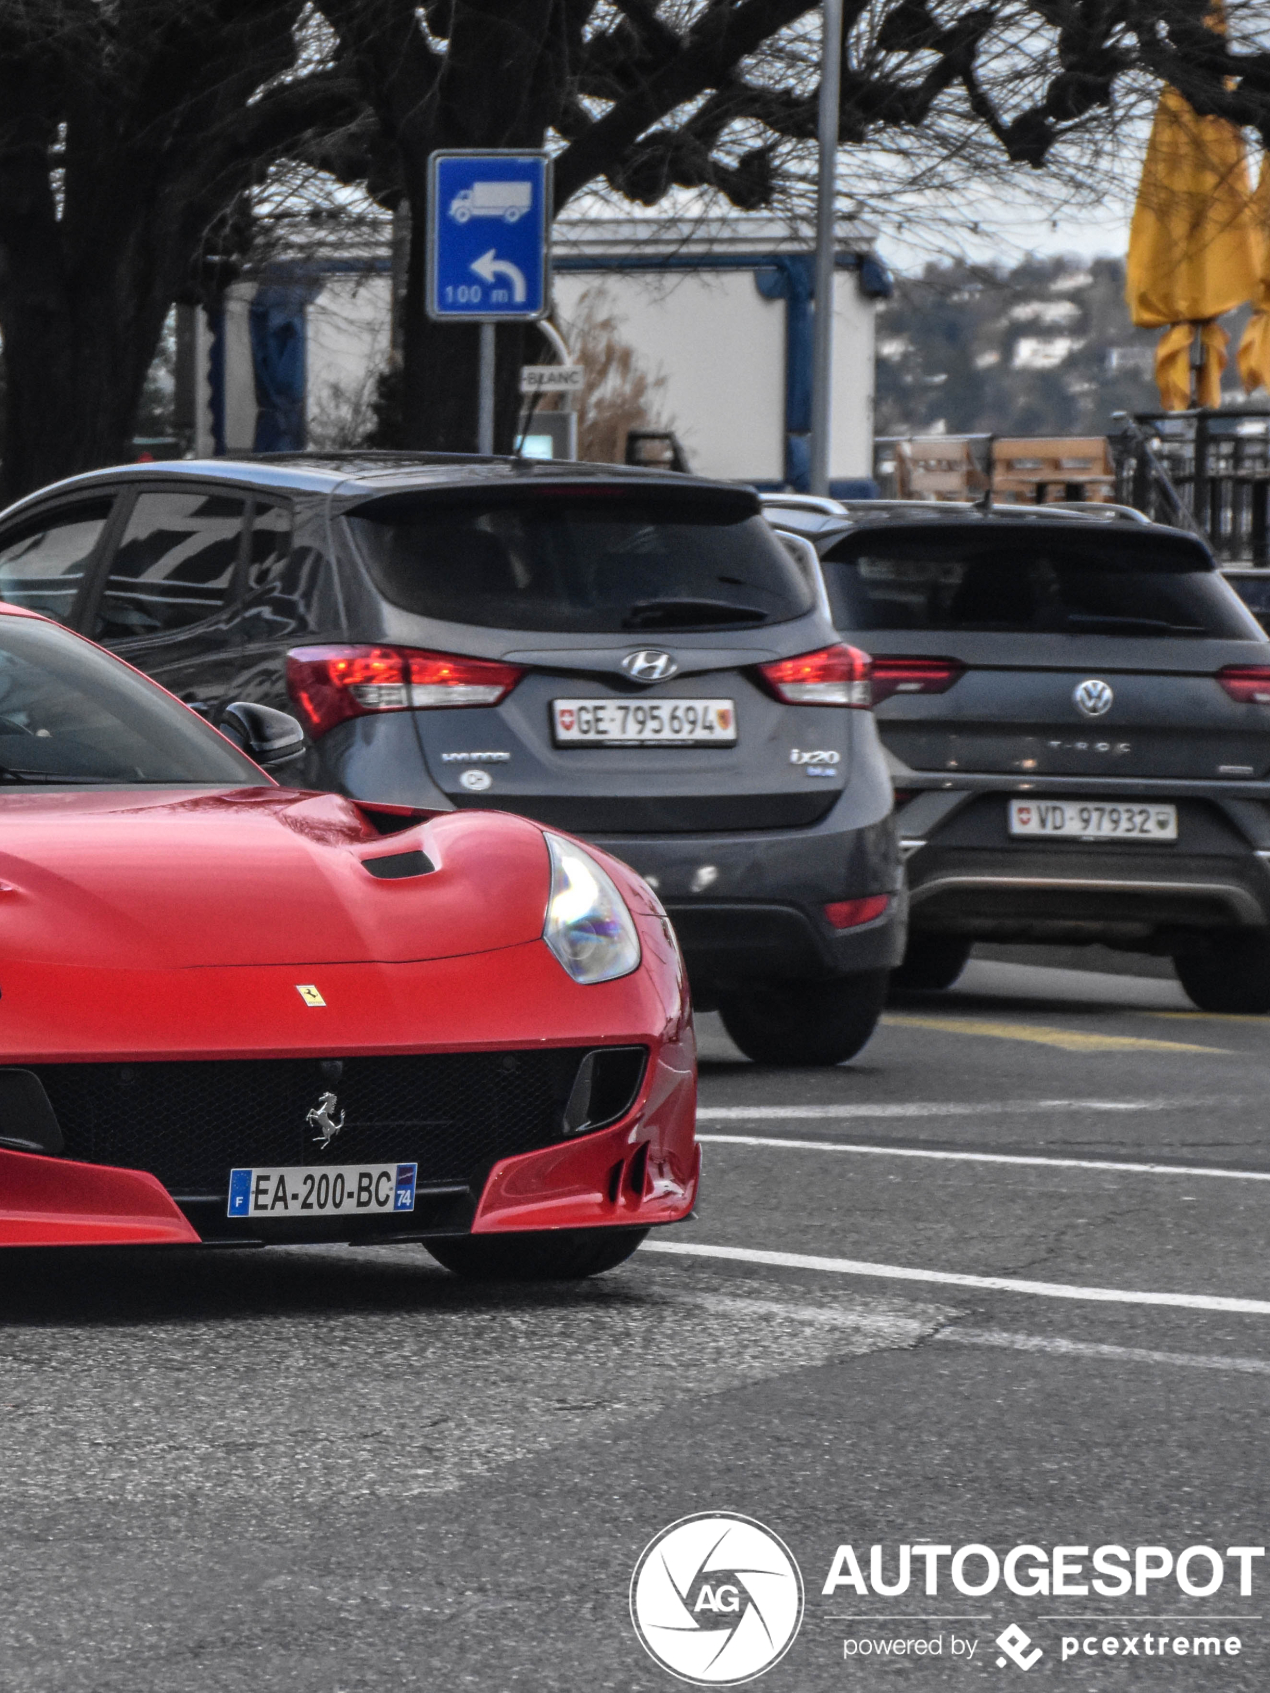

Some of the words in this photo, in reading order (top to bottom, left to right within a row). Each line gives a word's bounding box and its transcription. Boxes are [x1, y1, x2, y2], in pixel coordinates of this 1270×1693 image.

[445, 285, 481, 303] 100
[491, 289, 509, 303] m
[790, 748, 840, 764] ix20
[253, 1170, 392, 1211] EA-200-BC
[396, 1190, 412, 1206] 74
[235, 1196, 244, 1208] F
